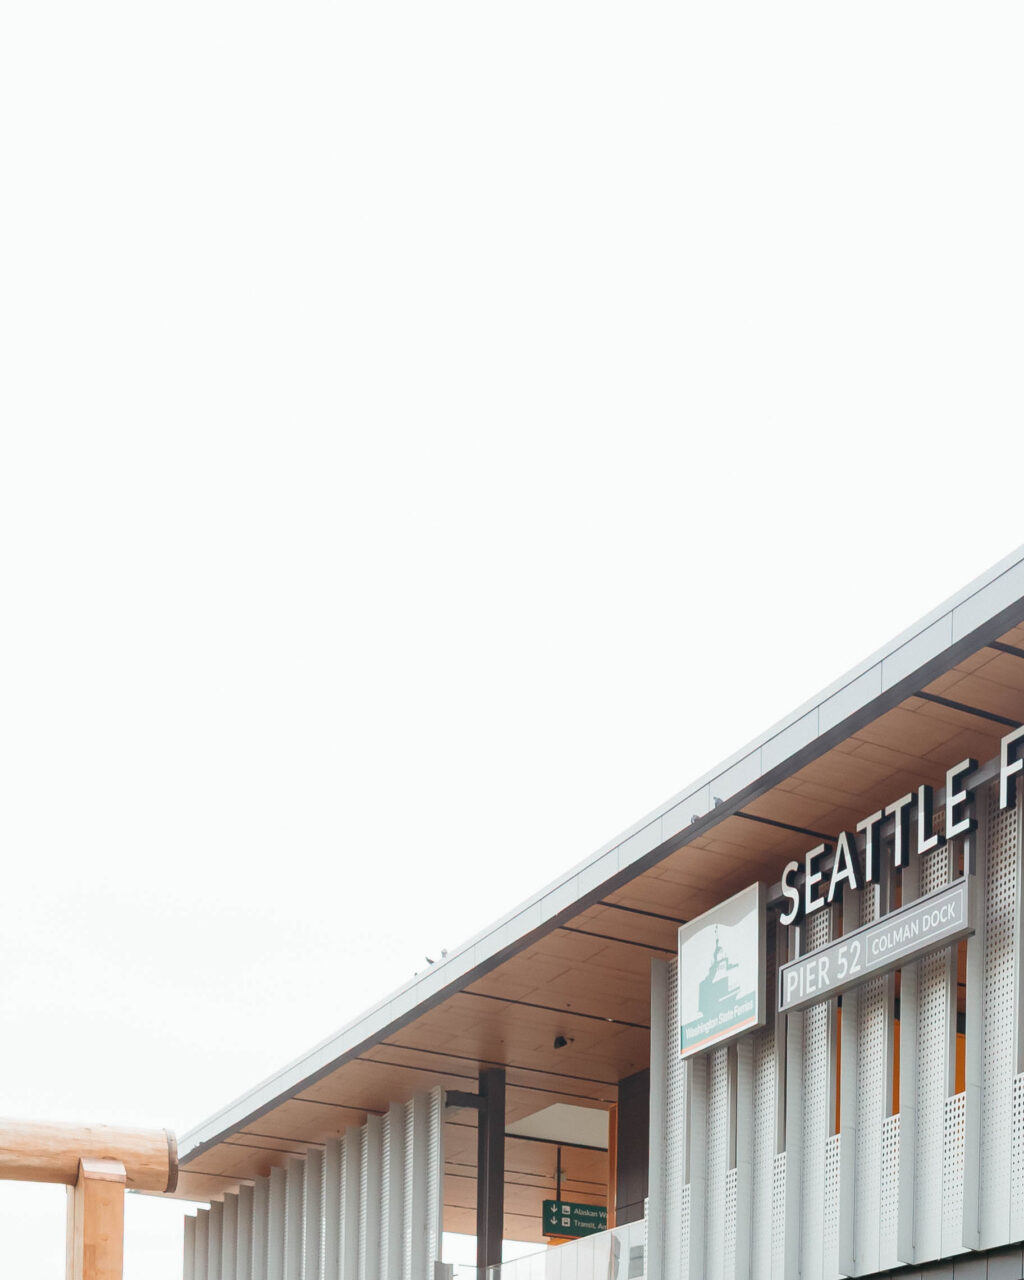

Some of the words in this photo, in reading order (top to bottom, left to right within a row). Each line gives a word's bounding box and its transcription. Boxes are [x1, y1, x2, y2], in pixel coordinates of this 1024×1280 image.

[779, 757, 976, 926] SEATTLE
[786, 955, 831, 1004] PIER
[836, 939, 862, 980] 52
[871, 919, 919, 956] COLMAN
[922, 900, 956, 932] DOCK
[573, 1207, 598, 1218] Alaskan
